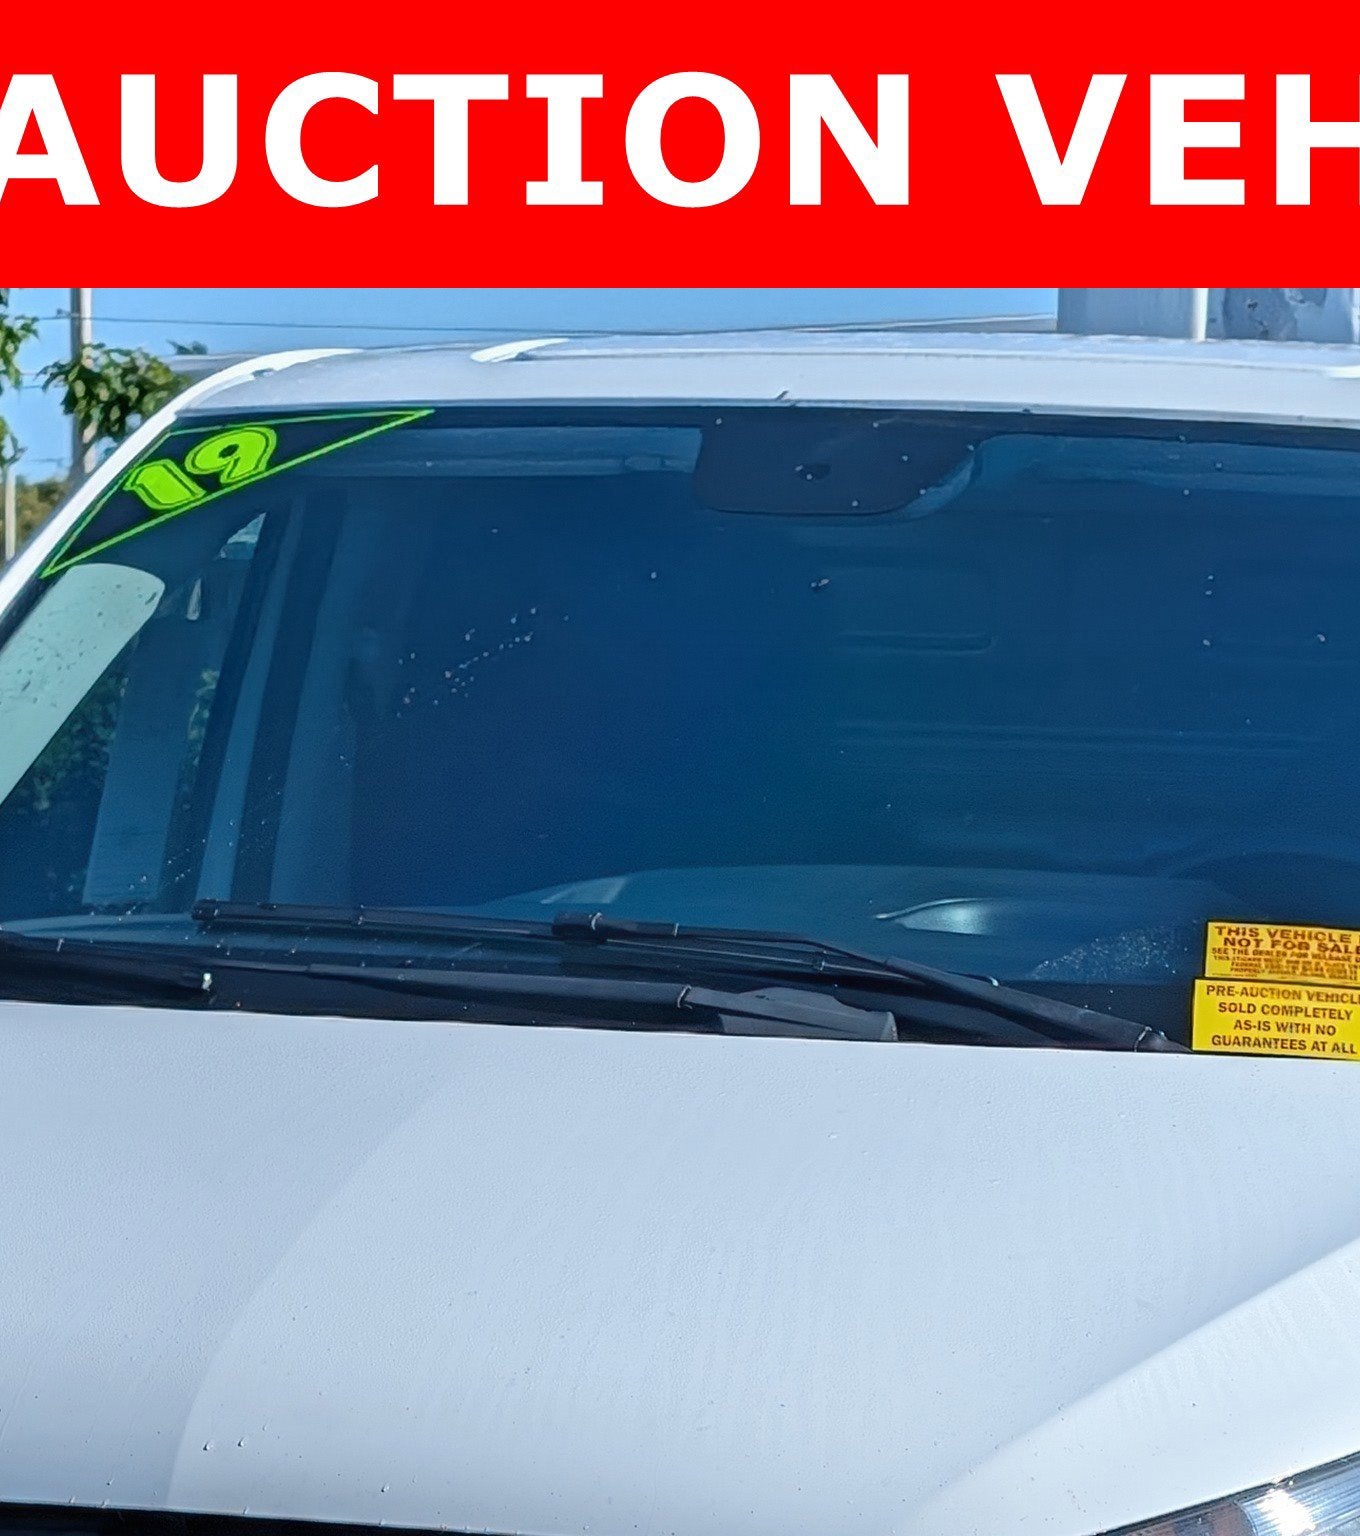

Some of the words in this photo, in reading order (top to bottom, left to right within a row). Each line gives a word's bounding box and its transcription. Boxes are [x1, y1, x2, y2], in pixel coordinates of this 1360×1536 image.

[123, 426, 278, 511] 19
[1214, 925, 1260, 938] THIS
[1266, 928, 1352, 943] VEHICLE
[1223, 937, 1264, 948] NOT
[1271, 939, 1311, 951] FOR
[1206, 984, 1302, 1000] PRE-AUCTION
[1218, 1002, 1257, 1014] SOLD
[1261, 1004, 1353, 1020] COMPLETELY
[1233, 1019, 1271, 1032] AS-IS
[1275, 1021, 1311, 1034] WITH
[1315, 1024, 1337, 1036] NO
[1211, 1034, 1307, 1051] GUARANTEES
[1311, 1040, 1328, 1052] AT
[1331, 1042, 1358, 1055] ALL
